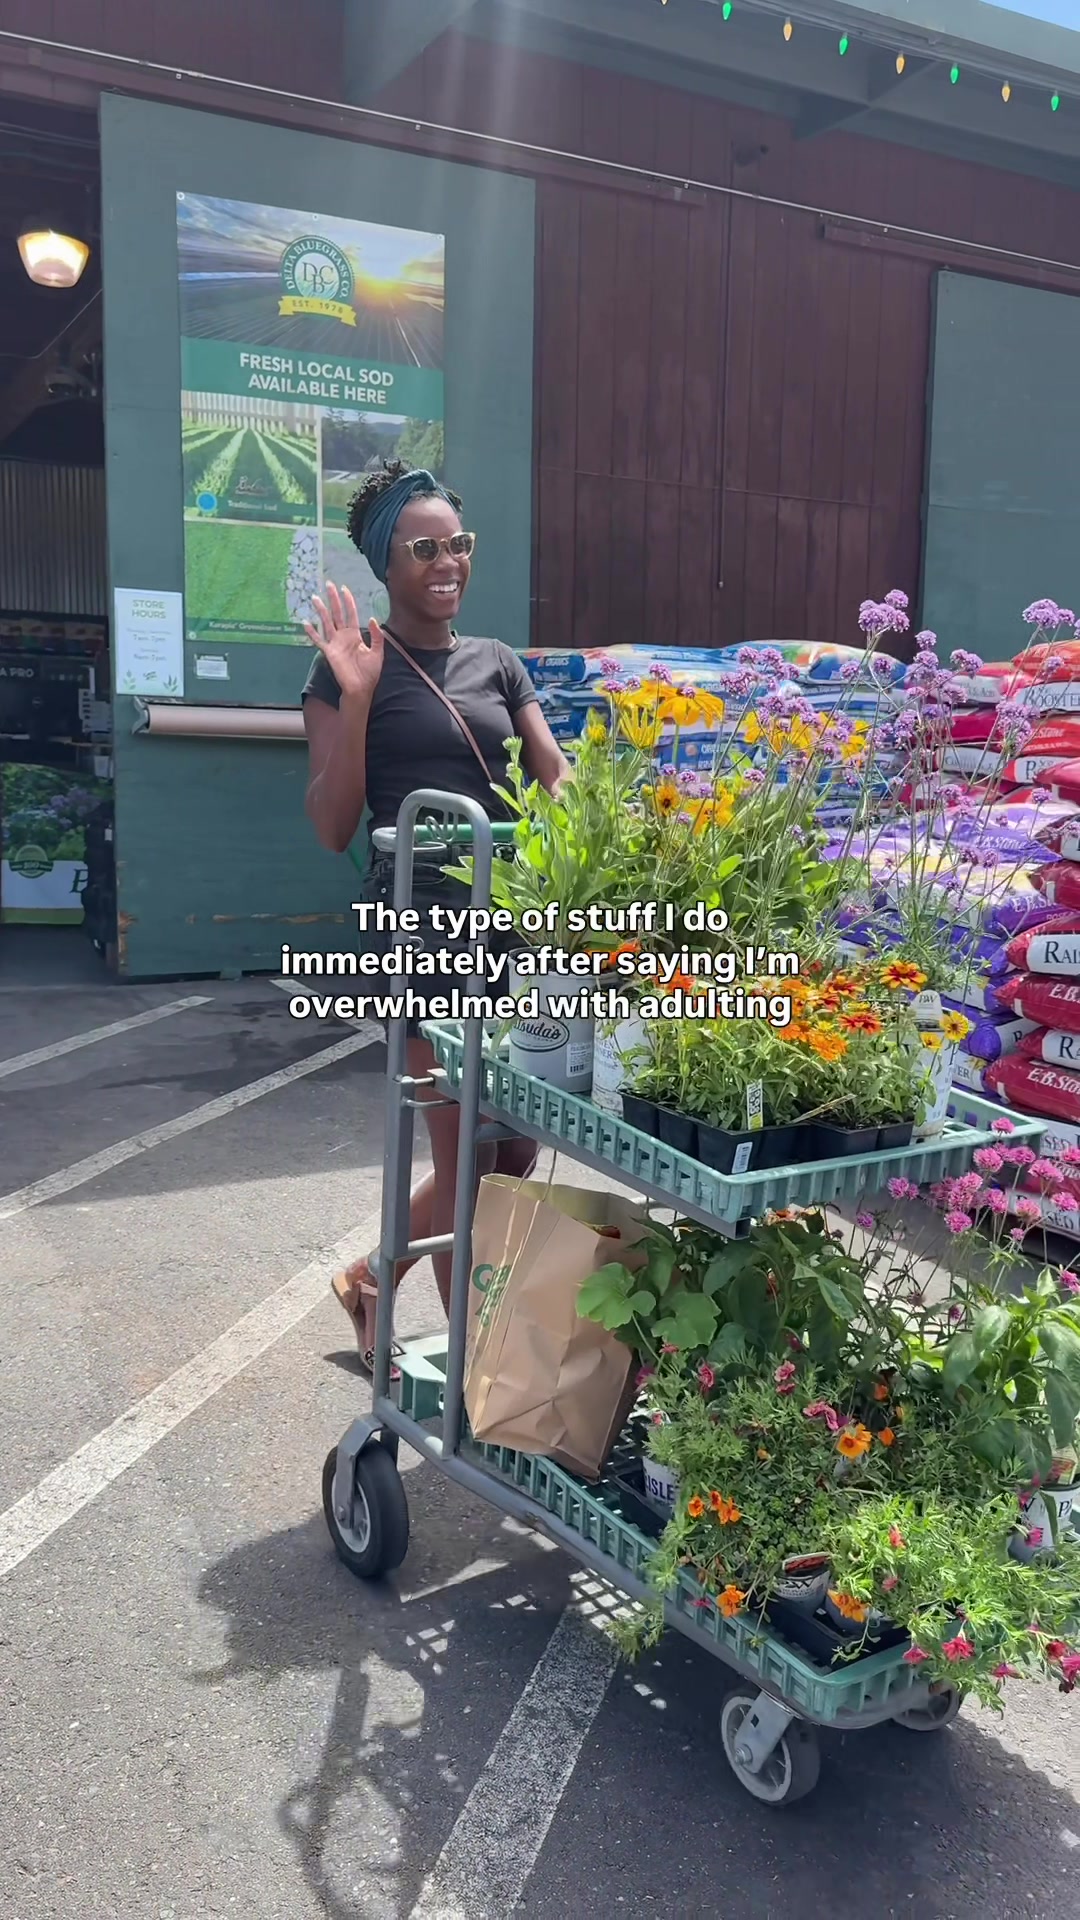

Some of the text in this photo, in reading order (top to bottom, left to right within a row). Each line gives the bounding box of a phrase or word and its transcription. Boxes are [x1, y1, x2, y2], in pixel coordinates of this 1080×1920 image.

[284, 255, 297, 290] DELTA
[294, 240, 349, 278] BLUEGRASS
[239, 352, 394, 387] FRESH LOCAL SOD
[248, 373, 387, 405] AVAILABLE HERE
[131, 609, 167, 619] HOURS
[132, 599, 166, 609] STORE
